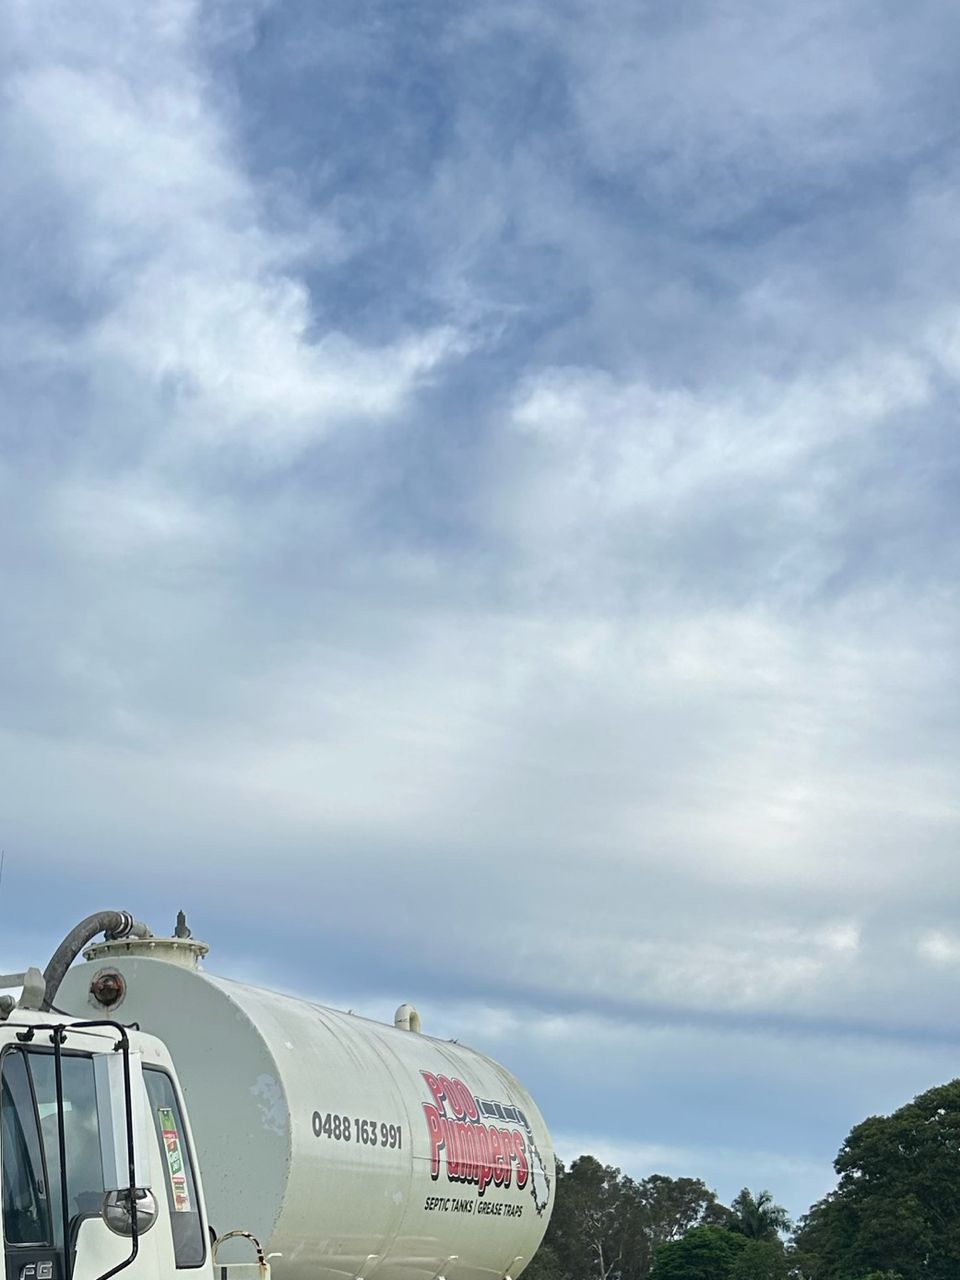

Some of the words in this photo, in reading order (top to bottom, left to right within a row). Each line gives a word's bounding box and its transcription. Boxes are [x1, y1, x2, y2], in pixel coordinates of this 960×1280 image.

[420, 1070, 480, 1124] POO
[312, 1110, 352, 1142] 0488
[354, 1118, 378, 1146] 163
[380, 1122, 402, 1150] 991
[424, 1196, 451, 1212] SEPTIC
[451, 1198, 474, 1214] TANKS
[477, 1201, 503, 1216] GREASE
[503, 1203, 523, 1218] TRAPS
[20, 1261, 53, 1280] FG
